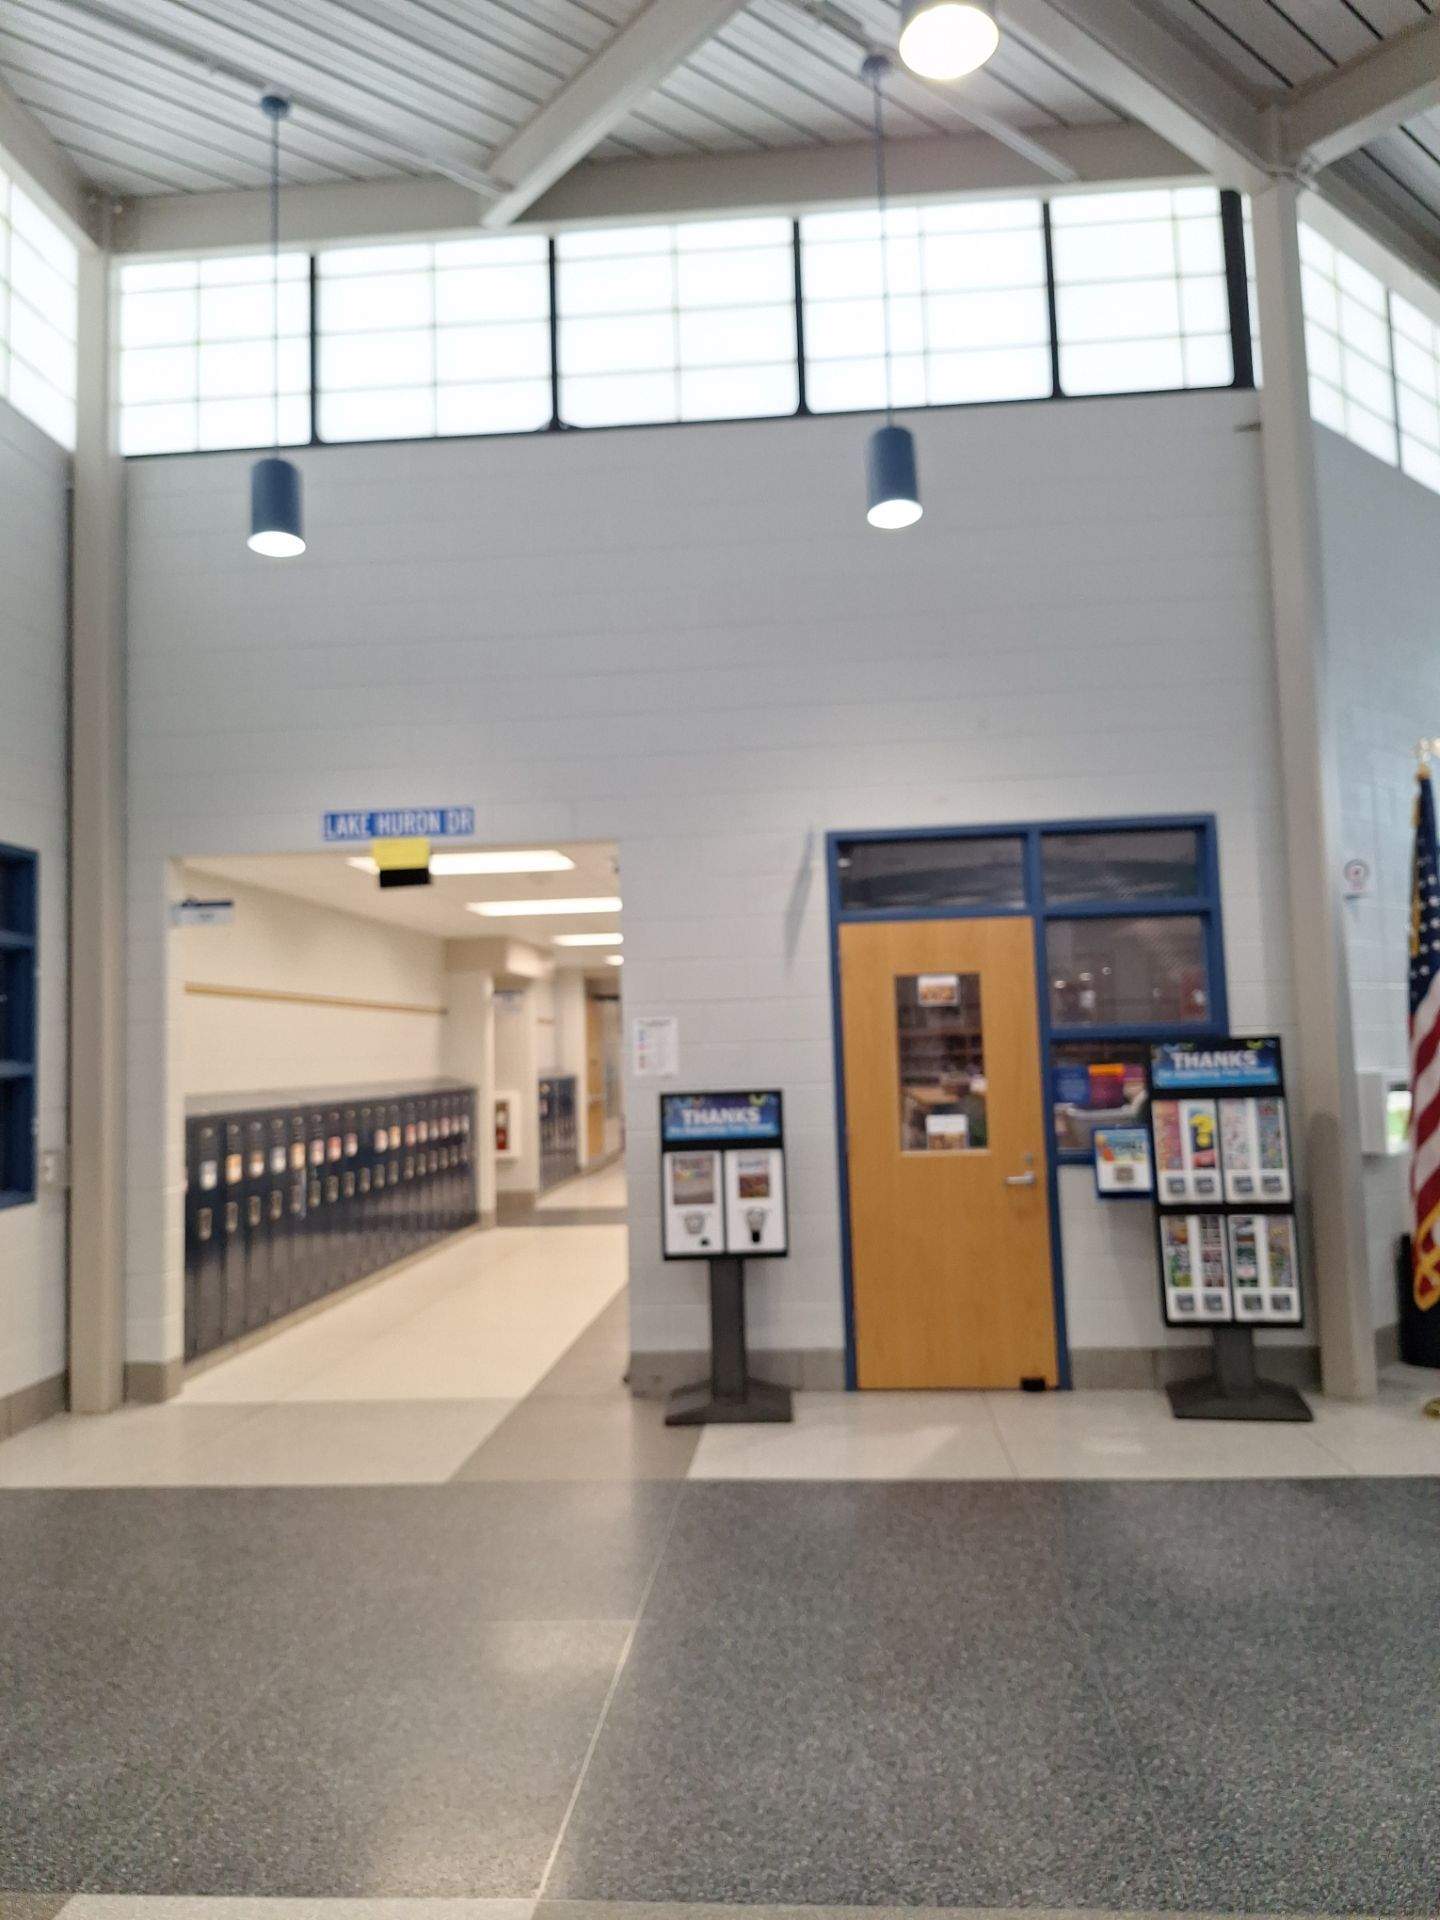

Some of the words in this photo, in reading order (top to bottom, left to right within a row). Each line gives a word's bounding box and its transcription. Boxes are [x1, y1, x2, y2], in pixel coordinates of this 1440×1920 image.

[326, 813, 371, 838] LAKE
[378, 809, 440, 835] HURON
[448, 807, 473, 833] DR
[1169, 1050, 1258, 1070] THANKS
[681, 1107, 760, 1125] THANKS
